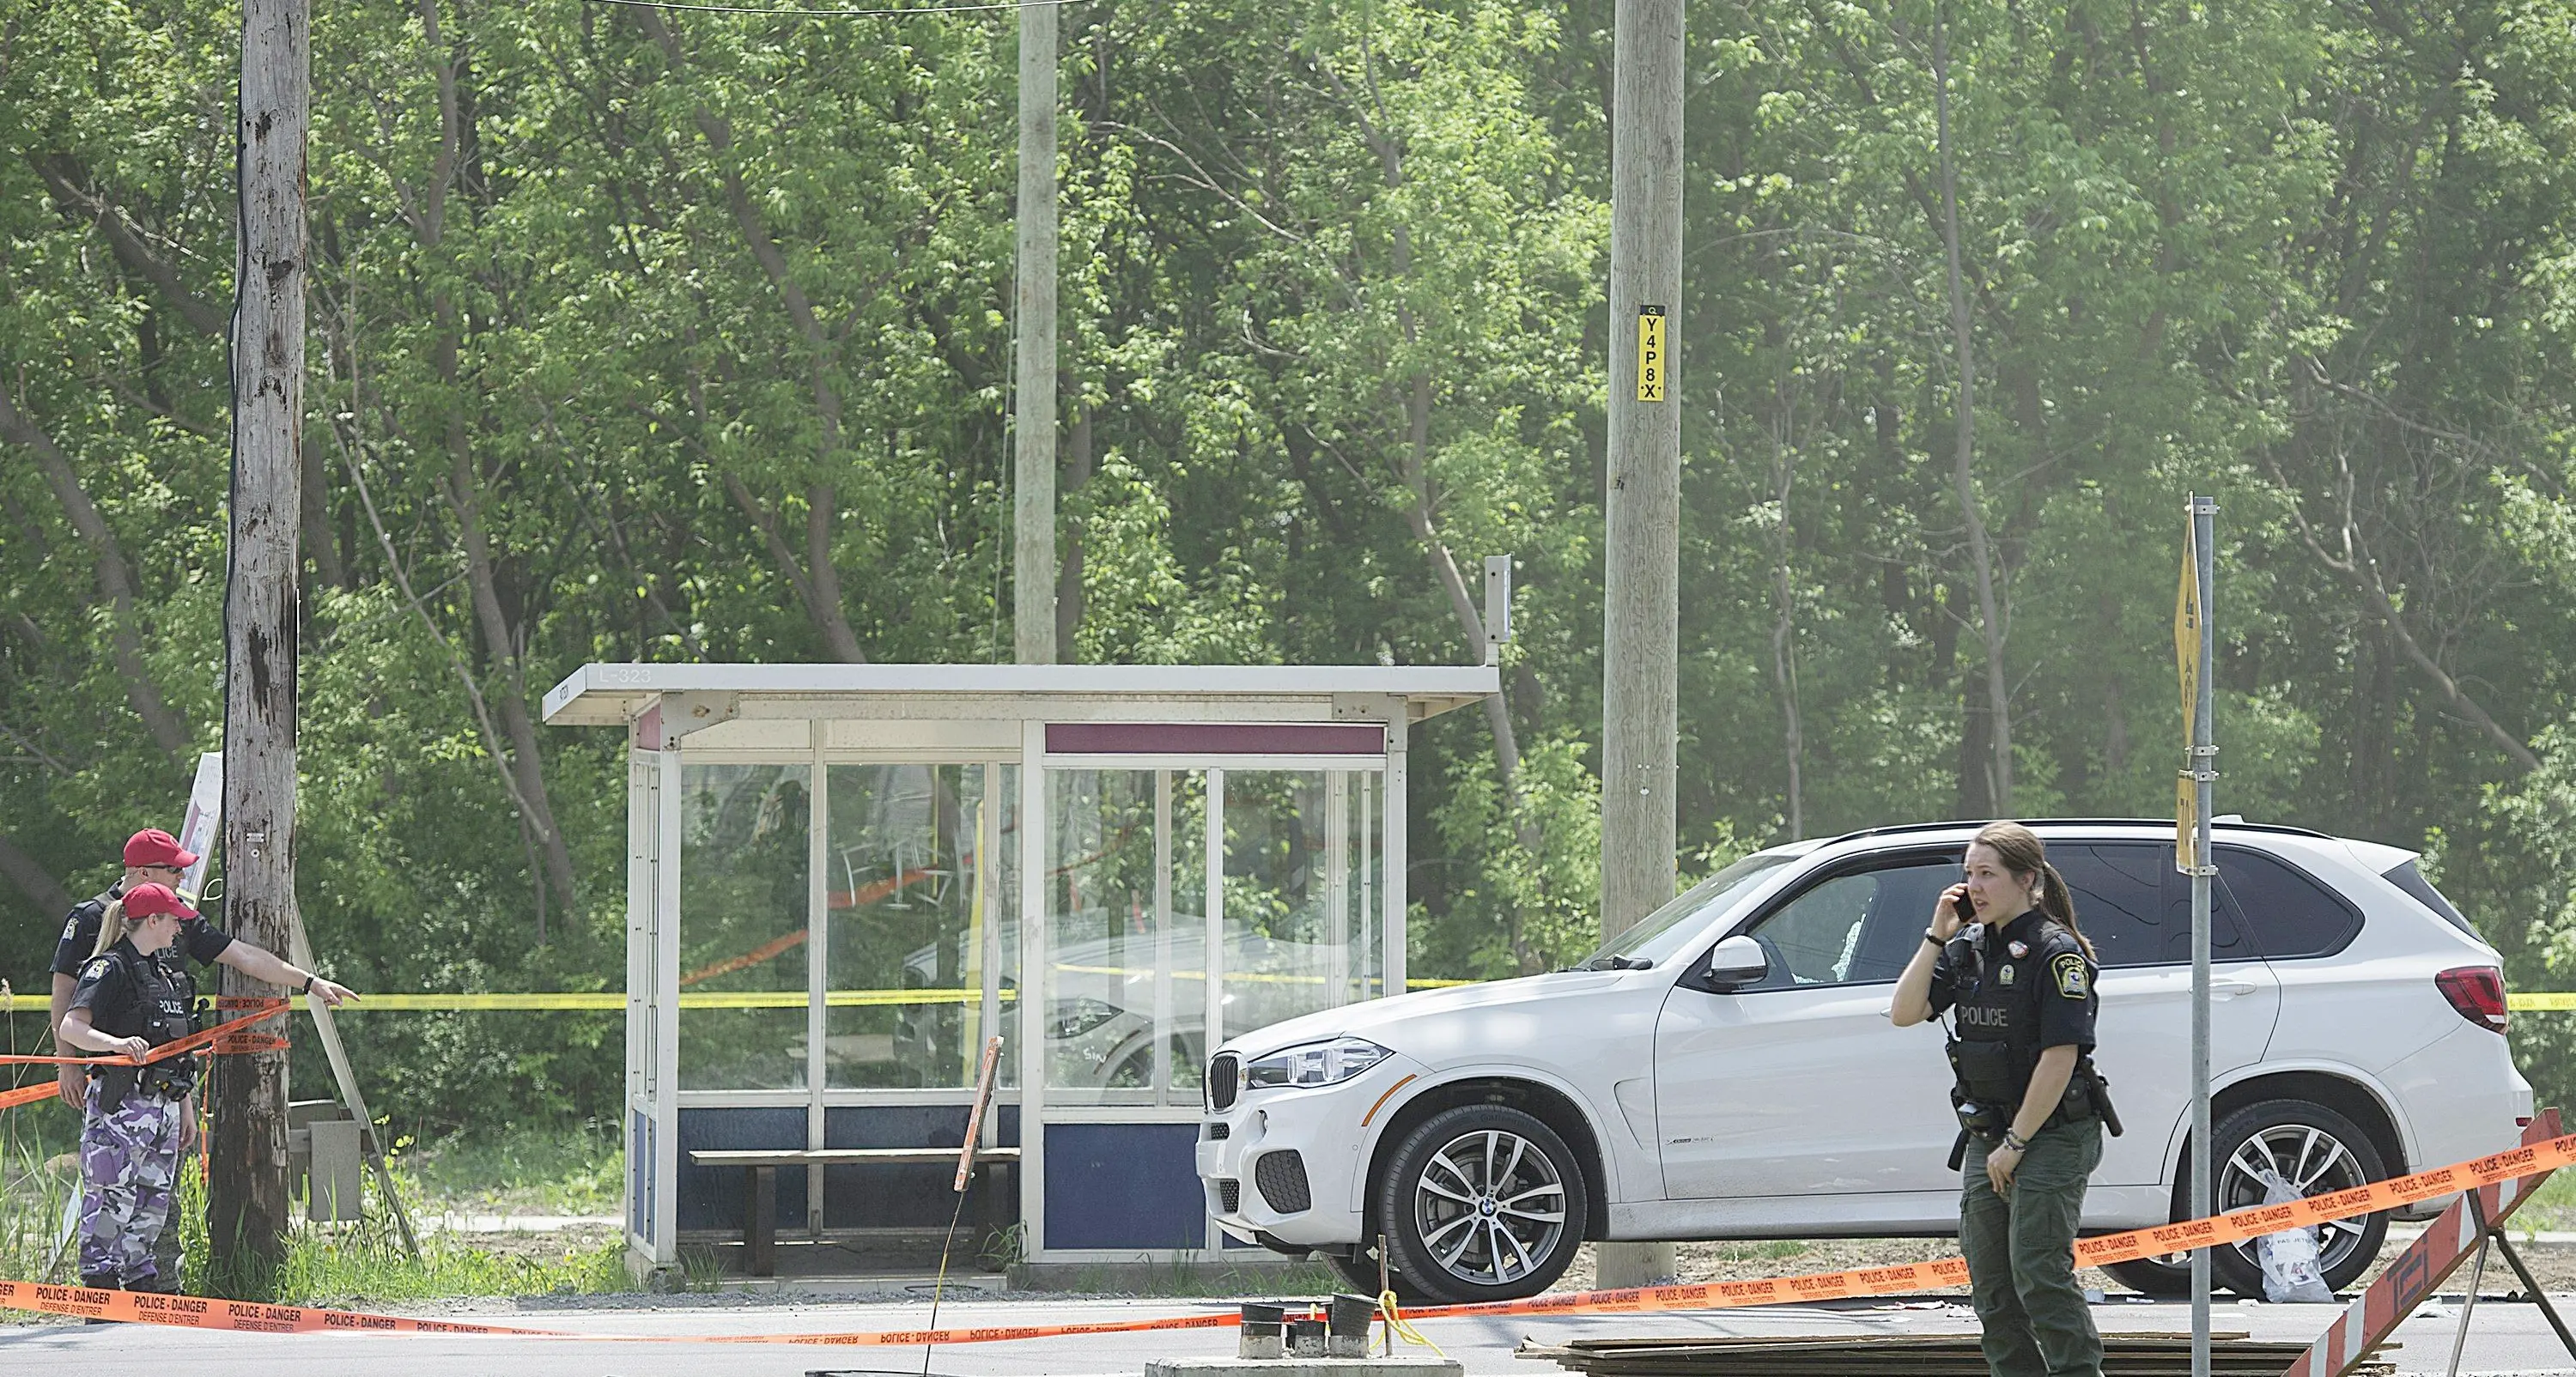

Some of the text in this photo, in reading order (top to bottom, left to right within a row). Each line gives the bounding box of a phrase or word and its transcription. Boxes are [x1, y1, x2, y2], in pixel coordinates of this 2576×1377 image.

[1644, 318, 1657, 398] Y4P8X
[598, 669, 651, 683] L-323
[155, 945, 179, 959] LICE
[159, 999, 184, 1014] POLICE
[1960, 1005, 2008, 1027] POLICE
[2469, 1148, 2537, 1175] POLICE DANGER
[2389, 1169, 2456, 1195] POLICE DANGER
[2308, 1189, 2373, 1213] POLICE DANGER
[2231, 1206, 2294, 1228] POLICE DANGER
[2153, 1222, 2215, 1243] POLICE DANGER
[2078, 1235, 2140, 1255] POLICE DANGER
[1859, 1267, 1917, 1284] POLICE DANGER
[1931, 1262, 1956, 1276] POLICE
[1722, 1282, 1776, 1297] POLICE DANGER
[1790, 1275, 1847, 1292] POLICE DANGER
[36, 1287, 110, 1305] POLICE DANGER
[1590, 1291, 1640, 1305] POLICE DANGER
[1656, 1287, 1708, 1301] POLICE DANGER
[134, 1295, 207, 1313] POLICE DANGER
[168, 1313, 199, 1325] D'ENTRER
[228, 1304, 301, 1322] POLICE DANGER
[325, 1313, 396, 1330] POLICE DANGER
[417, 1322, 447, 1332] POLICE
